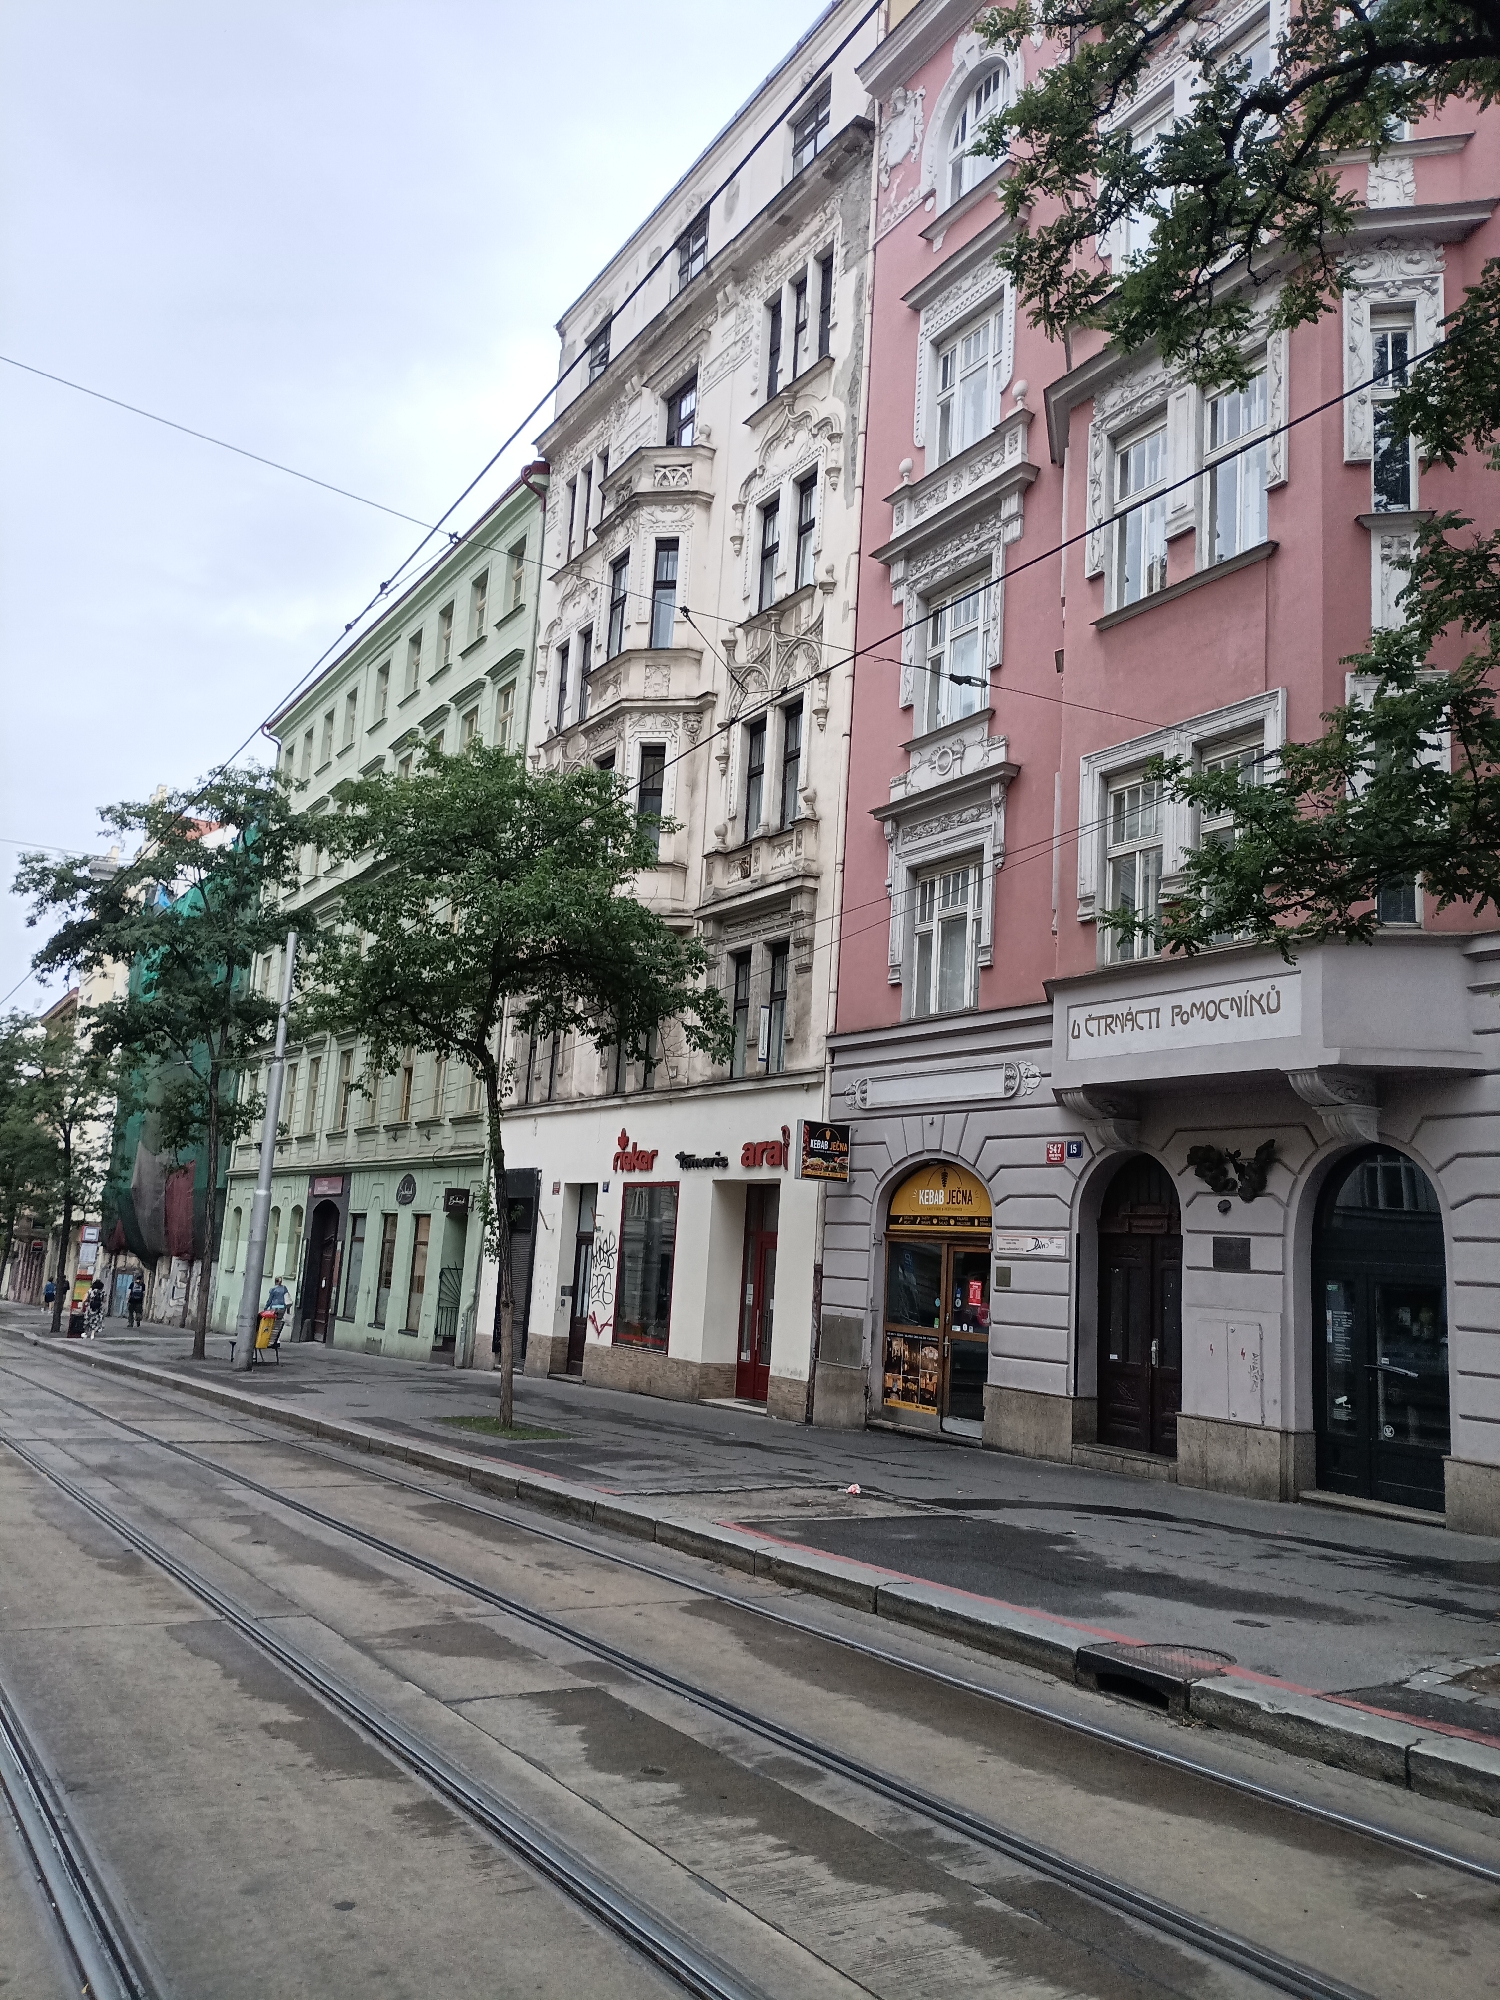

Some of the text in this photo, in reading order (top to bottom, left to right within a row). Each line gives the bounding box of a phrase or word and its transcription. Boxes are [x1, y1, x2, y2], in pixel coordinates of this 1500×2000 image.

[1071, 1020, 1080, 1039] U
[1085, 1006, 1160, 1037] ČTRNÁCTI
[613, 1128, 658, 1171] rieker
[810, 1139, 848, 1151] KEBAB JEČNA
[1070, 1144, 1077, 1153] 15
[919, 1187, 973, 1205] KEBAB JEČNA
